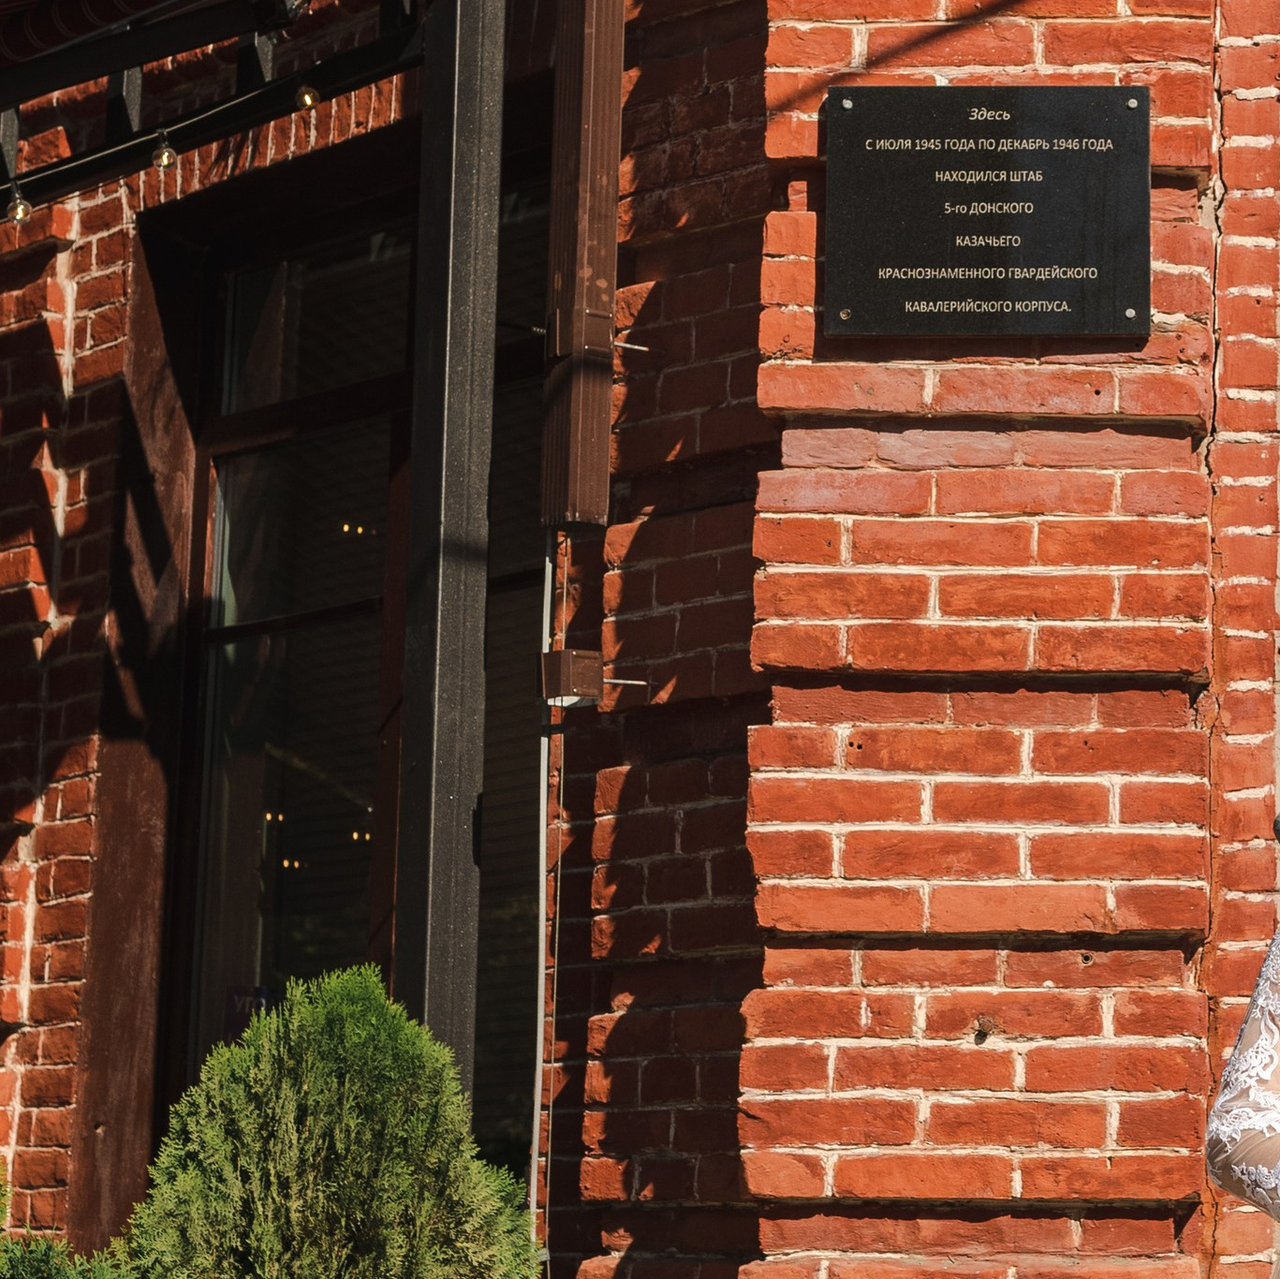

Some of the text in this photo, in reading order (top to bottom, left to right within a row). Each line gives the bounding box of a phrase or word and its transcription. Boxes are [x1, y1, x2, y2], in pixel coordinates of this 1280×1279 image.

[968, 107, 1011, 121] Здесь
[865, 138, 1114, 152] С ИЮЛЯ 1945 ГОДА ПО ДЕКАБРЬ 1946 ГОДА
[935, 170, 1044, 184] НАХОДИЛСЯ ШТАБ
[944, 202, 1034, 216] 5-го ДОНСКОГО
[955, 235, 1021, 247] КАЗАЧЬЕГО
[878, 264, 1098, 280] КРАСНОЗНАМЕННОГО ГВАРДЕЙСКОГО
[905, 298, 1072, 313] КАВАЛЕРИЙСКОГО КОРПУСА.
